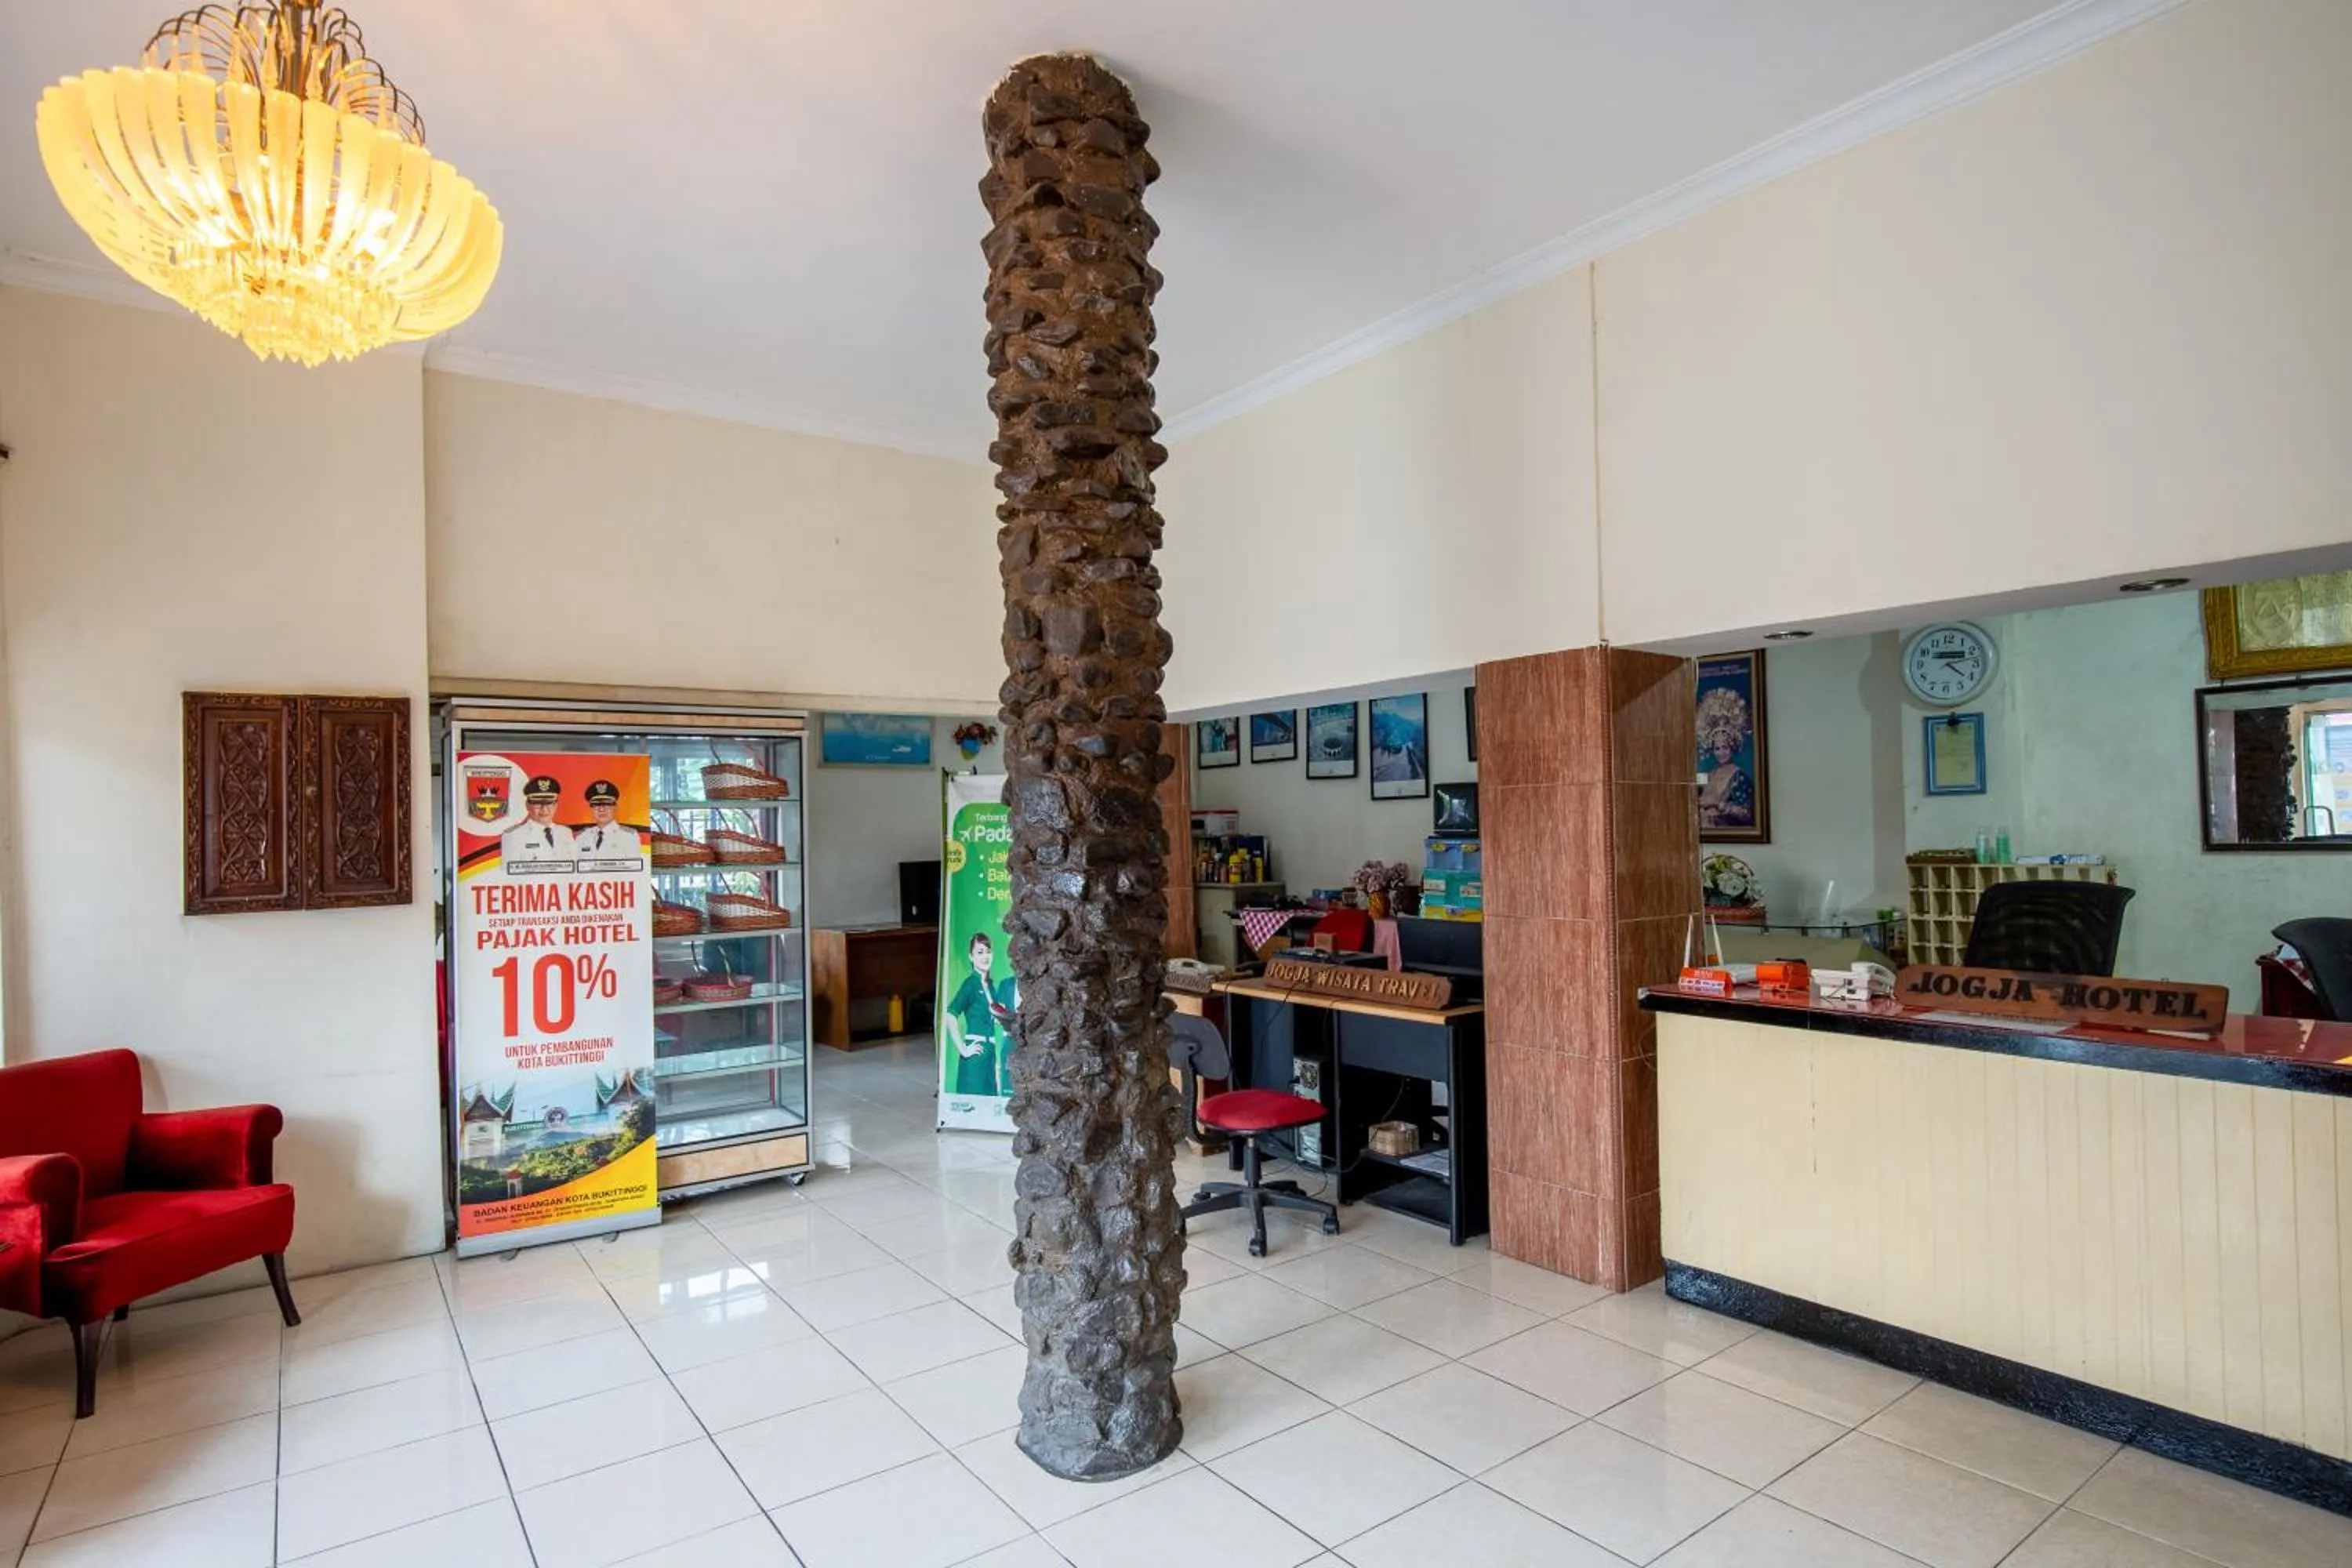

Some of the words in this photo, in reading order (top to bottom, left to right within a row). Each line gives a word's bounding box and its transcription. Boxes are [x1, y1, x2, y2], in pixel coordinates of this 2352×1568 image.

[471, 884, 561, 915] TERIMA
[568, 880, 634, 910] KASIH
[477, 927, 556, 950] PAJAK
[564, 924, 640, 945] HOTEL
[492, 953, 617, 1037] 10%
[1268, 962, 1310, 983] JOGJA
[1316, 969, 1370, 991] WISATA
[1378, 977, 1443, 1000] TRAVEL
[1907, 971, 2035, 1002] JOGJA
[2059, 983, 2207, 1018] HOTEL
[504, 1044, 539, 1058] UNTUK
[541, 1037, 613, 1054] PEMBANGUNAN
[517, 1057, 543, 1069] KOTA
[546, 1051, 604, 1067] BUKITTINGGI
[474, 1206, 507, 1218] BADAN
[510, 1197, 562, 1211] KEUANGAN
[565, 1193, 590, 1203] KOTA
[592, 1185, 648, 1200] BUKITTINGGI
